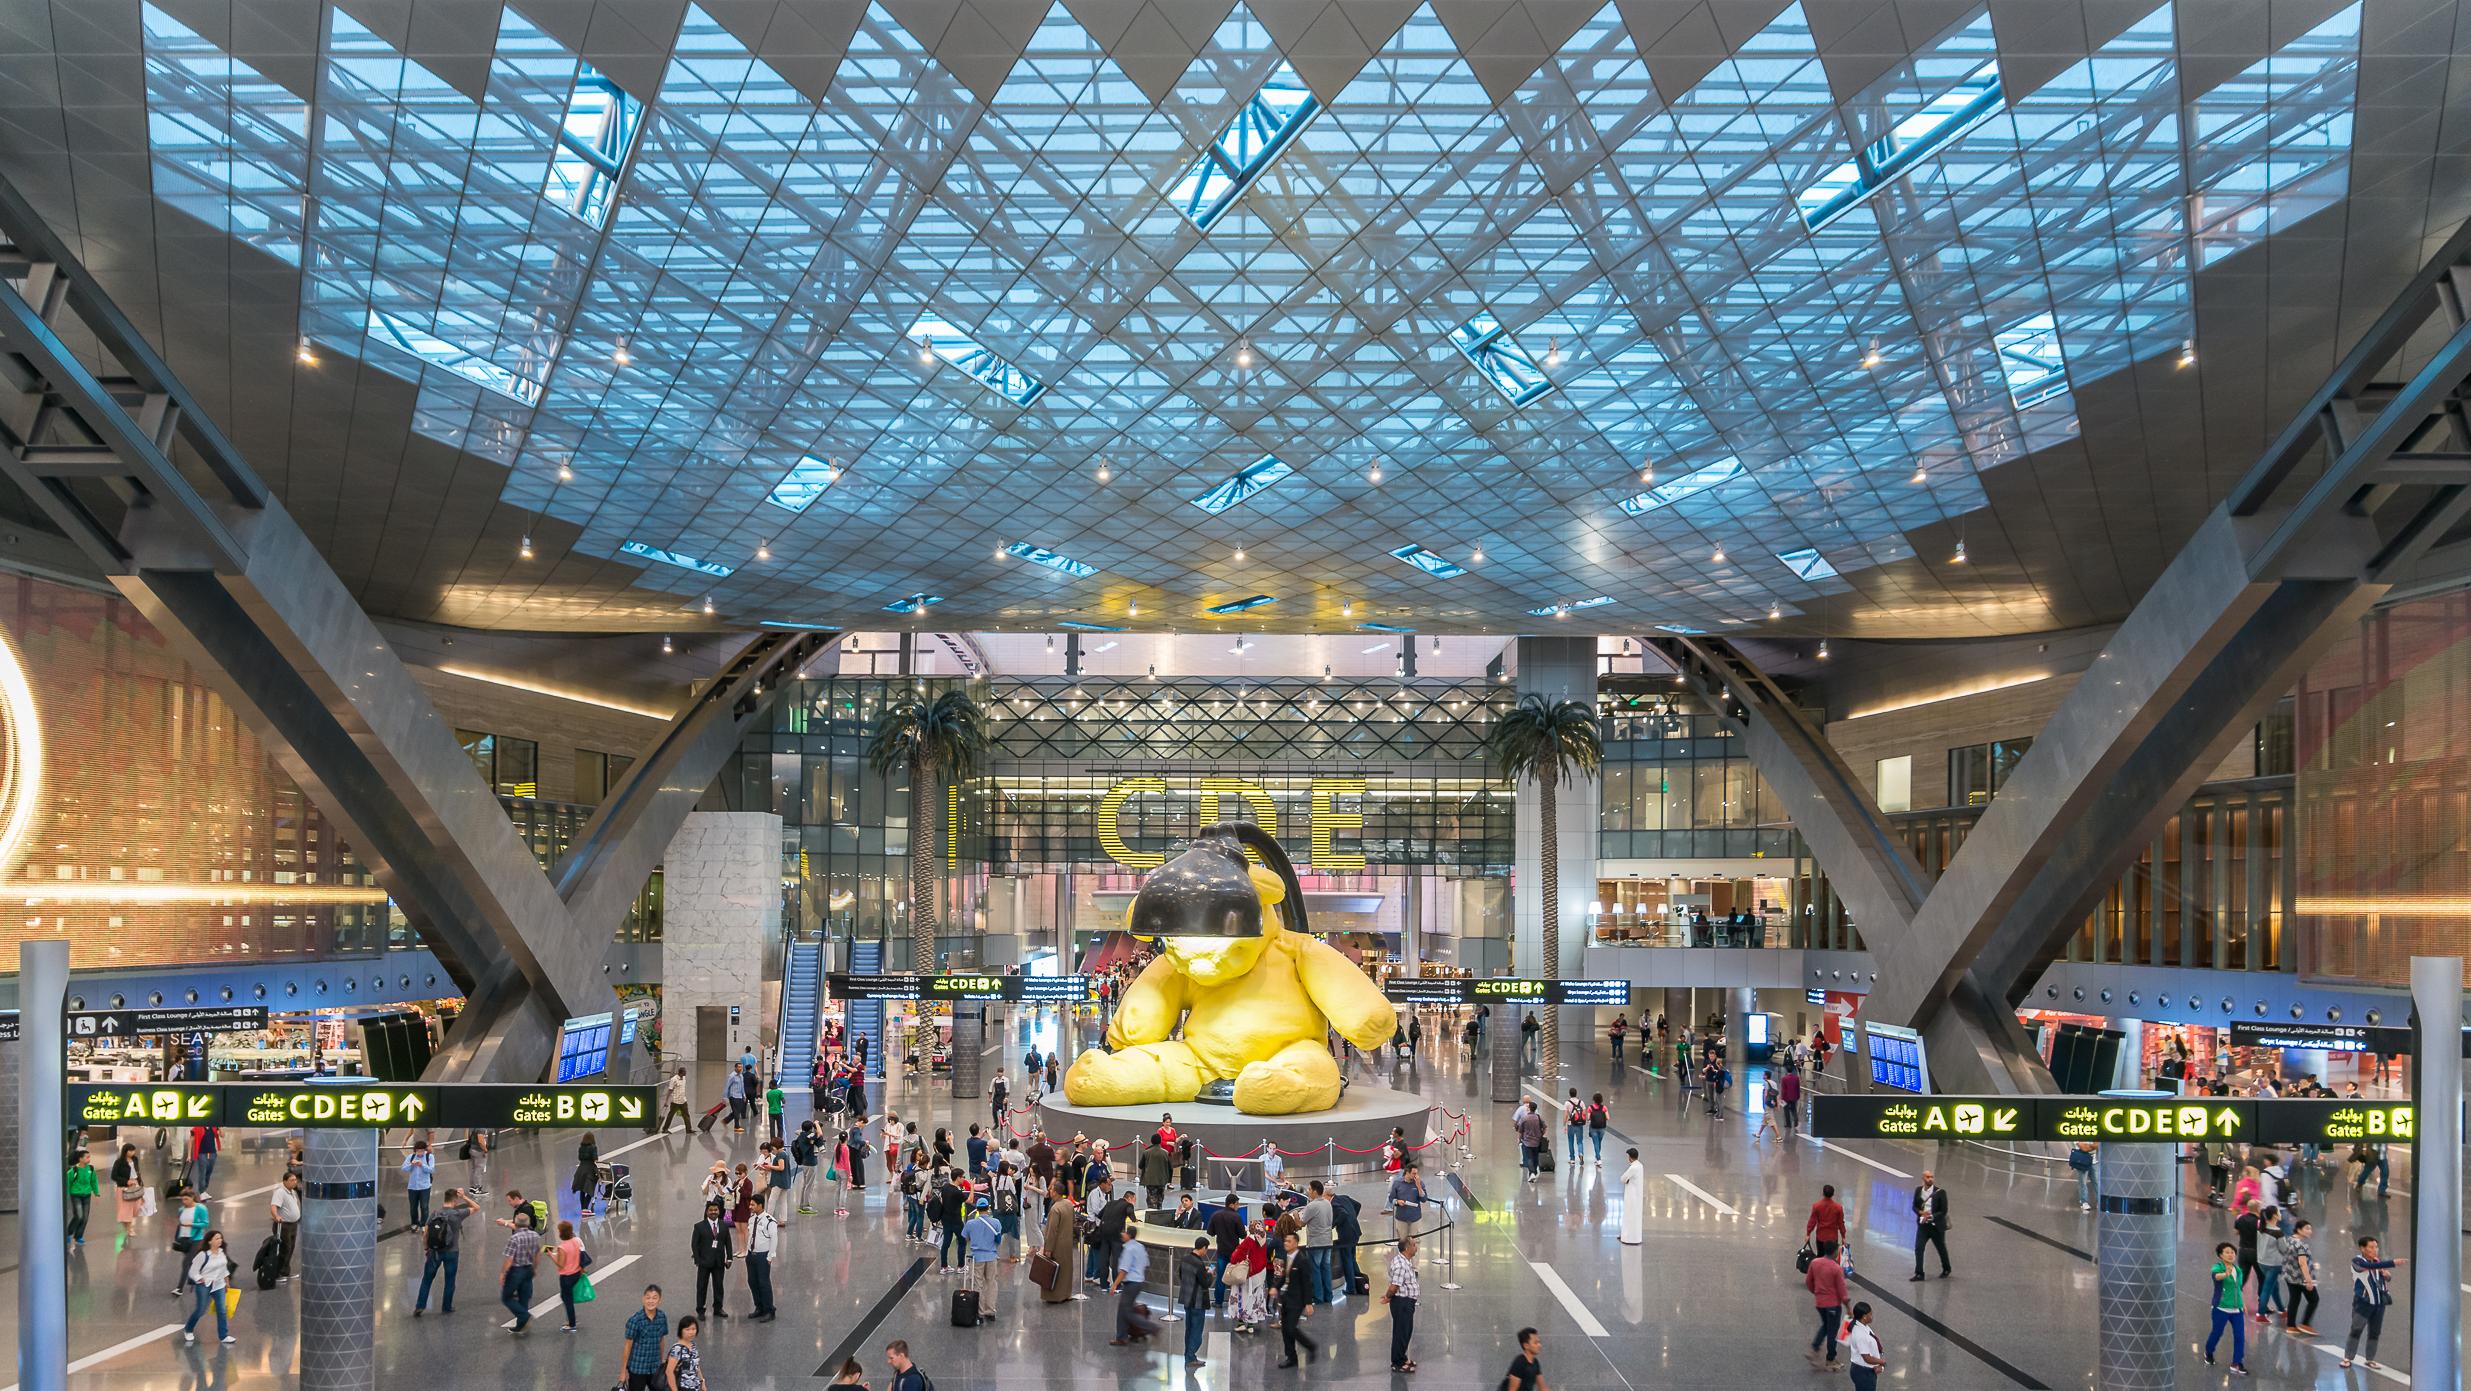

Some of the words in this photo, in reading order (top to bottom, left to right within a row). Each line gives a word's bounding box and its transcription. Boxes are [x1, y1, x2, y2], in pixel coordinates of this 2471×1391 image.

[950, 978, 976, 989] CDE
[1492, 982, 1518, 992] CDE
[170, 1032, 204, 1045] SEA
[2275, 1038, 2298, 1047] Lounge
[88, 1091, 120, 1106] بوابات
[253, 1093, 284, 1108] بوابات
[520, 1093, 551, 1108] بوابات
[82, 1106, 120, 1120] Gates
[124, 1093, 148, 1118] A
[248, 1108, 284, 1122] Gates
[290, 1094, 357, 1119] CDE
[514, 1109, 551, 1121] Gates
[557, 1095, 574, 1119] B
[1885, 1104, 1917, 1119] بوابات
[2065, 1106, 2098, 1122] بوابات
[1880, 1120, 1918, 1132] Gates
[1924, 1106, 1948, 1130] A
[2060, 1123, 2098, 1136] Gates
[2104, 1108, 2172, 1134] CDE
[2332, 1108, 2363, 1123] بوابات
[2327, 1124, 2363, 1137] Gates
[2368, 1110, 2386, 1134] B
